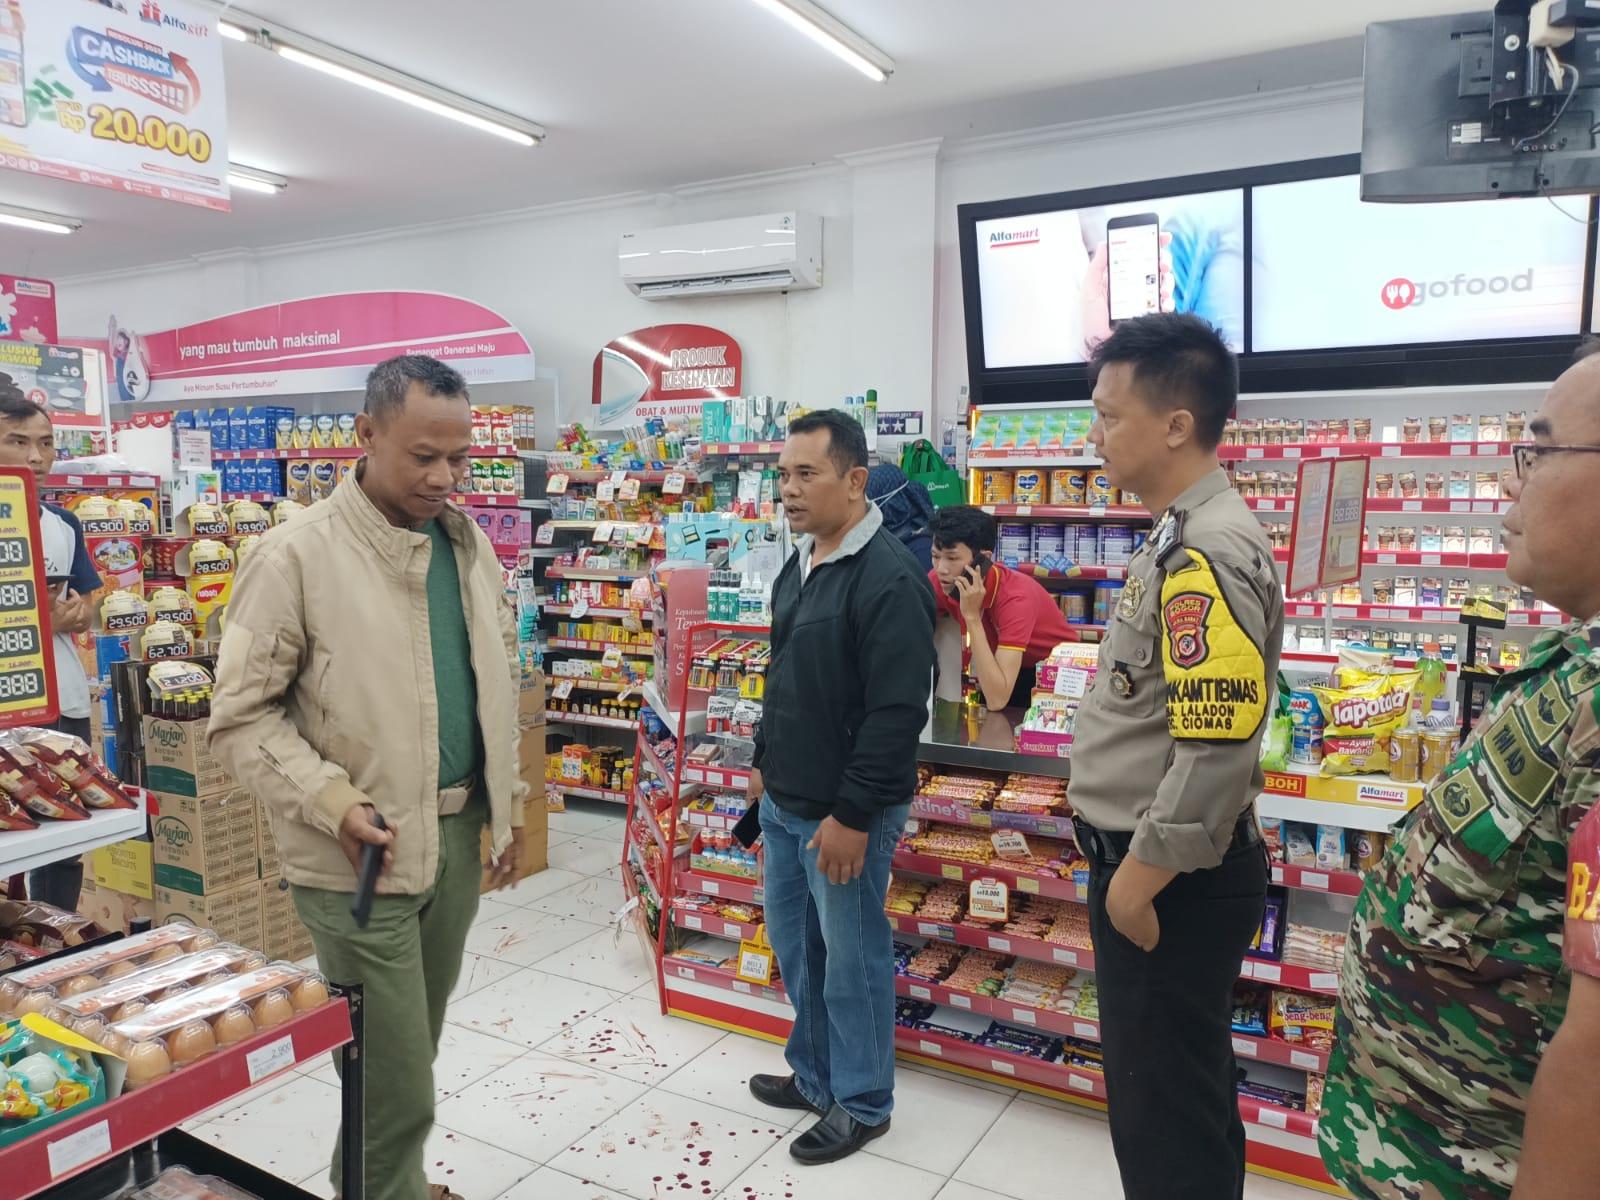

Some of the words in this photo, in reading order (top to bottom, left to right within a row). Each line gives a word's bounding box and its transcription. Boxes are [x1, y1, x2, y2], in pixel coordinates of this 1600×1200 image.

[81, 34, 173, 78] CASHBACK
[88, 103, 212, 163] 20.000
[989, 228, 1039, 245] Alfamart
[1409, 268, 1534, 308] gofood
[179, 343, 205, 360] yang
[207, 342, 230, 354] mau
[232, 337, 278, 353] tumbuh
[283, 330, 340, 348] maksimal
[443, 343, 476, 355] Generasi
[477, 342, 496, 354] Maju
[670, 345, 727, 368] PRODUK
[195, 383, 214, 392] Minum
[215, 382, 231, 392] Susu
[661, 367, 735, 390] KESEHATAN
[635, 407, 659, 416] OBAT
[660, 406, 667, 416] &
[109, 614, 147, 629] 29.500
[148, 644, 188, 659] 62.700
[1180, 703, 1235, 718] LALADON
[1182, 717, 1233, 731] CIOMAS
[151, 724, 184, 746] Marjan
[1359, 785, 1405, 799] Alfamart
[157, 824, 191, 846] Marjan
